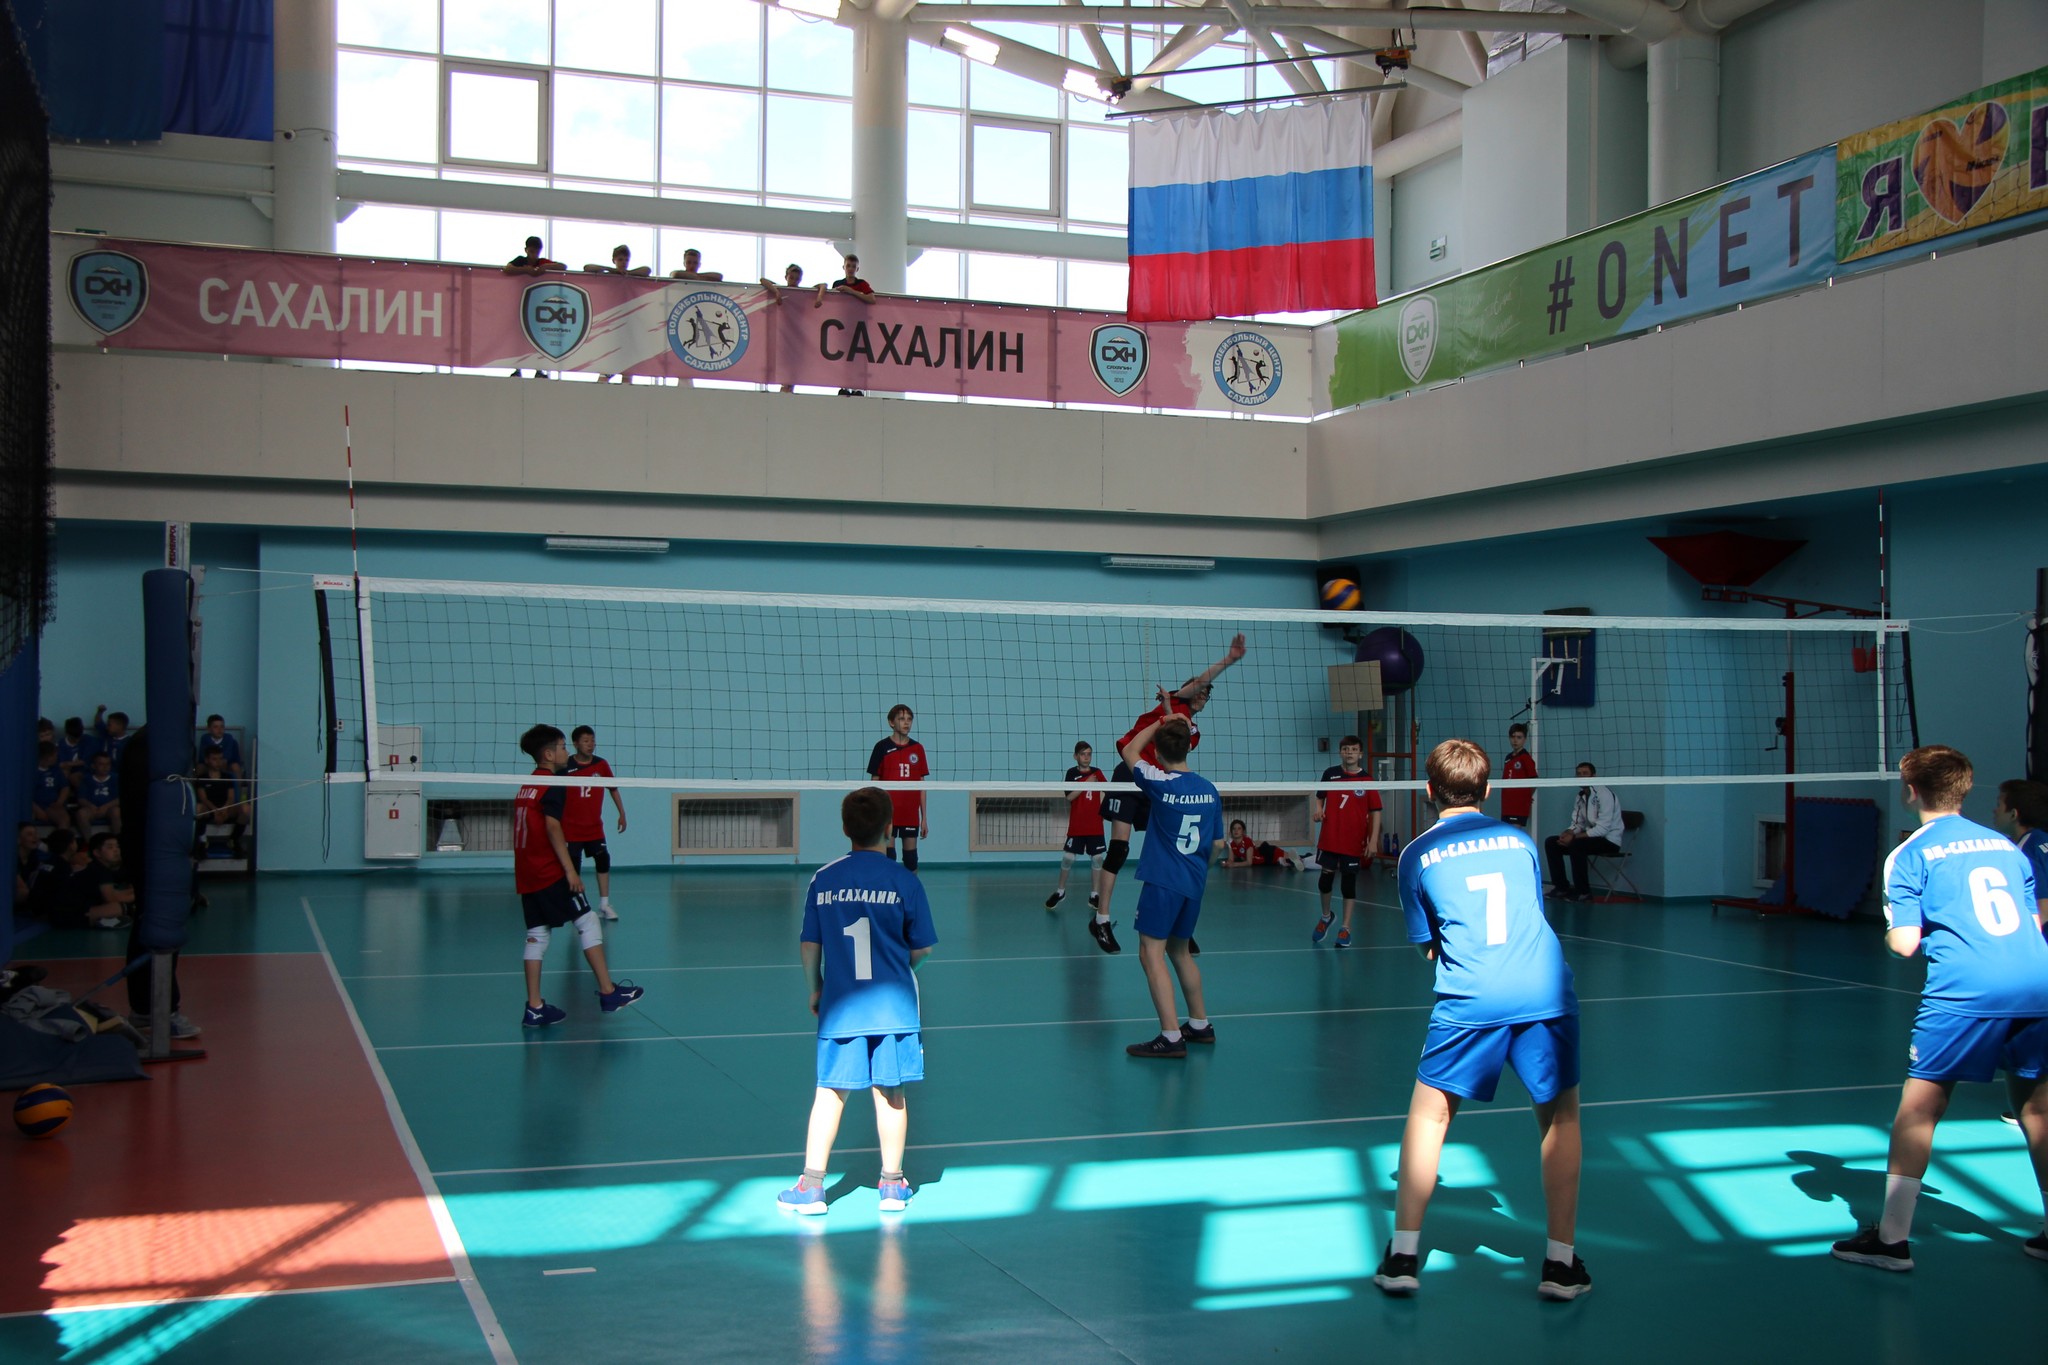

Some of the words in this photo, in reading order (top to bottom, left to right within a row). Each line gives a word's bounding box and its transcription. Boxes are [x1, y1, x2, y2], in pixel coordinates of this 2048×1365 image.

[1855, 156, 1905, 242] Я
[199, 277, 442, 337] САХАЛИН
[669, 293, 734, 335] ВОЛЕЙБОЛЬНЫЙ
[733, 307, 749, 340] ЦЕНТР
[684, 355, 733, 371] САХАЛИН
[819, 318, 1023, 373] САХАЛИН
[1214, 333, 1269, 372] ВОЛЕЙБОЛЬНЫЙ
[1267, 347, 1281, 377] ЦЕНТР
[1227, 390, 1268, 405] САХАЛИН
[898, 763, 911, 778] 13
[1108, 798, 1122, 814] 10
[1339, 794, 1350, 809] 7
[1066, 838, 1073, 848] 4
[1176, 814, 1202, 855] 5
[1465, 872, 1507, 946] 7
[1968, 866, 2021, 937] 6
[843, 917, 872, 980] 1
